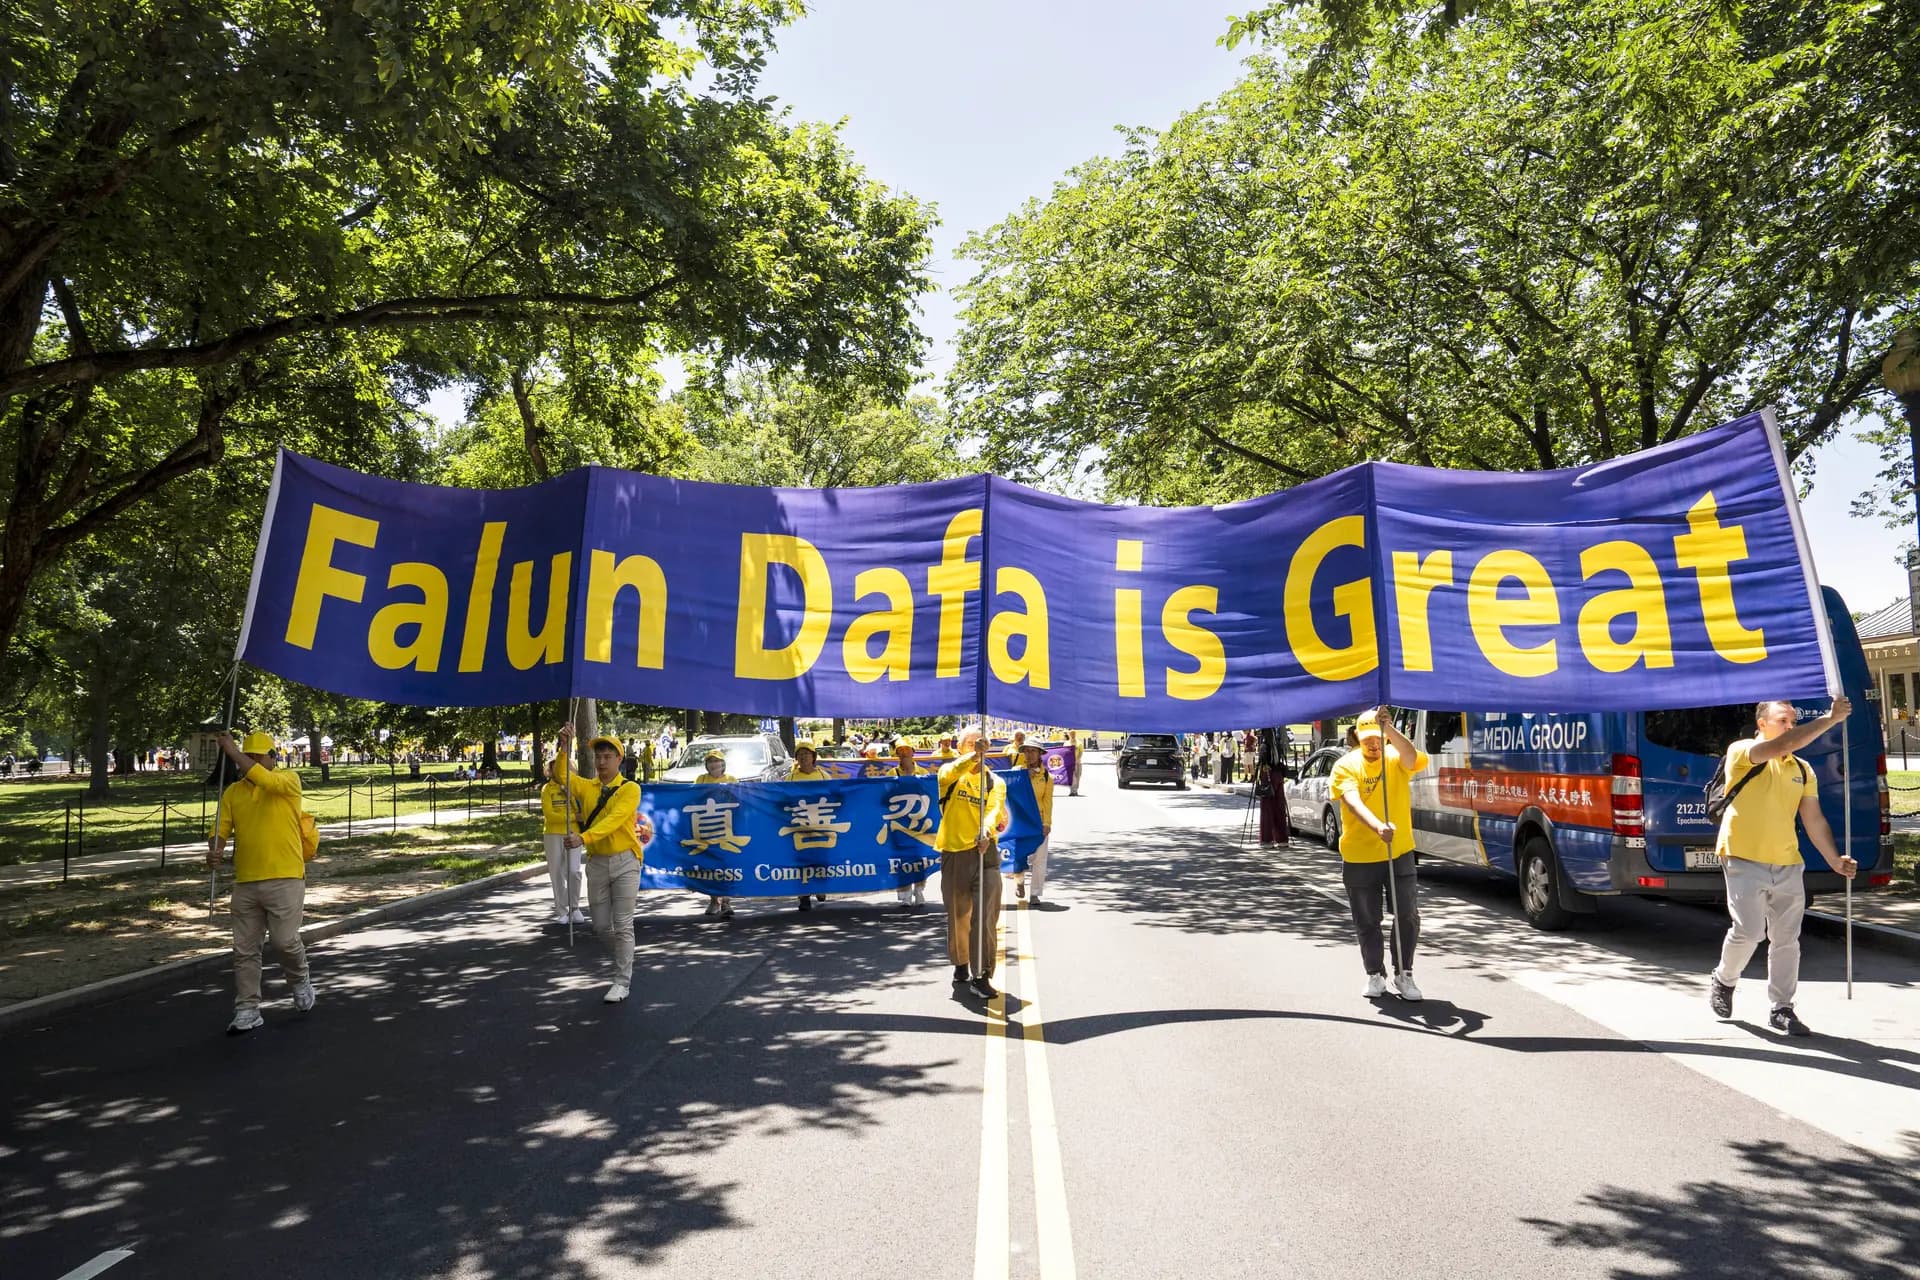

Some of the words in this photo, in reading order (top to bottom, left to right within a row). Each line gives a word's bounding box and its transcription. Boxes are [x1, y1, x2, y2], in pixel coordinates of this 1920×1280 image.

[285, 503, 667, 673] Falun
[735, 509, 1050, 689] Dafa
[1114, 540, 1227, 700] is
[1284, 490, 1767, 682] Great
[1868, 648, 1898, 660] IFTS
[1483, 726, 1526, 751] MEDIA
[1530, 721, 1587, 750] GROUP
[1676, 803, 1706, 815] 212.73
[755, 860, 876, 883] Compassion
